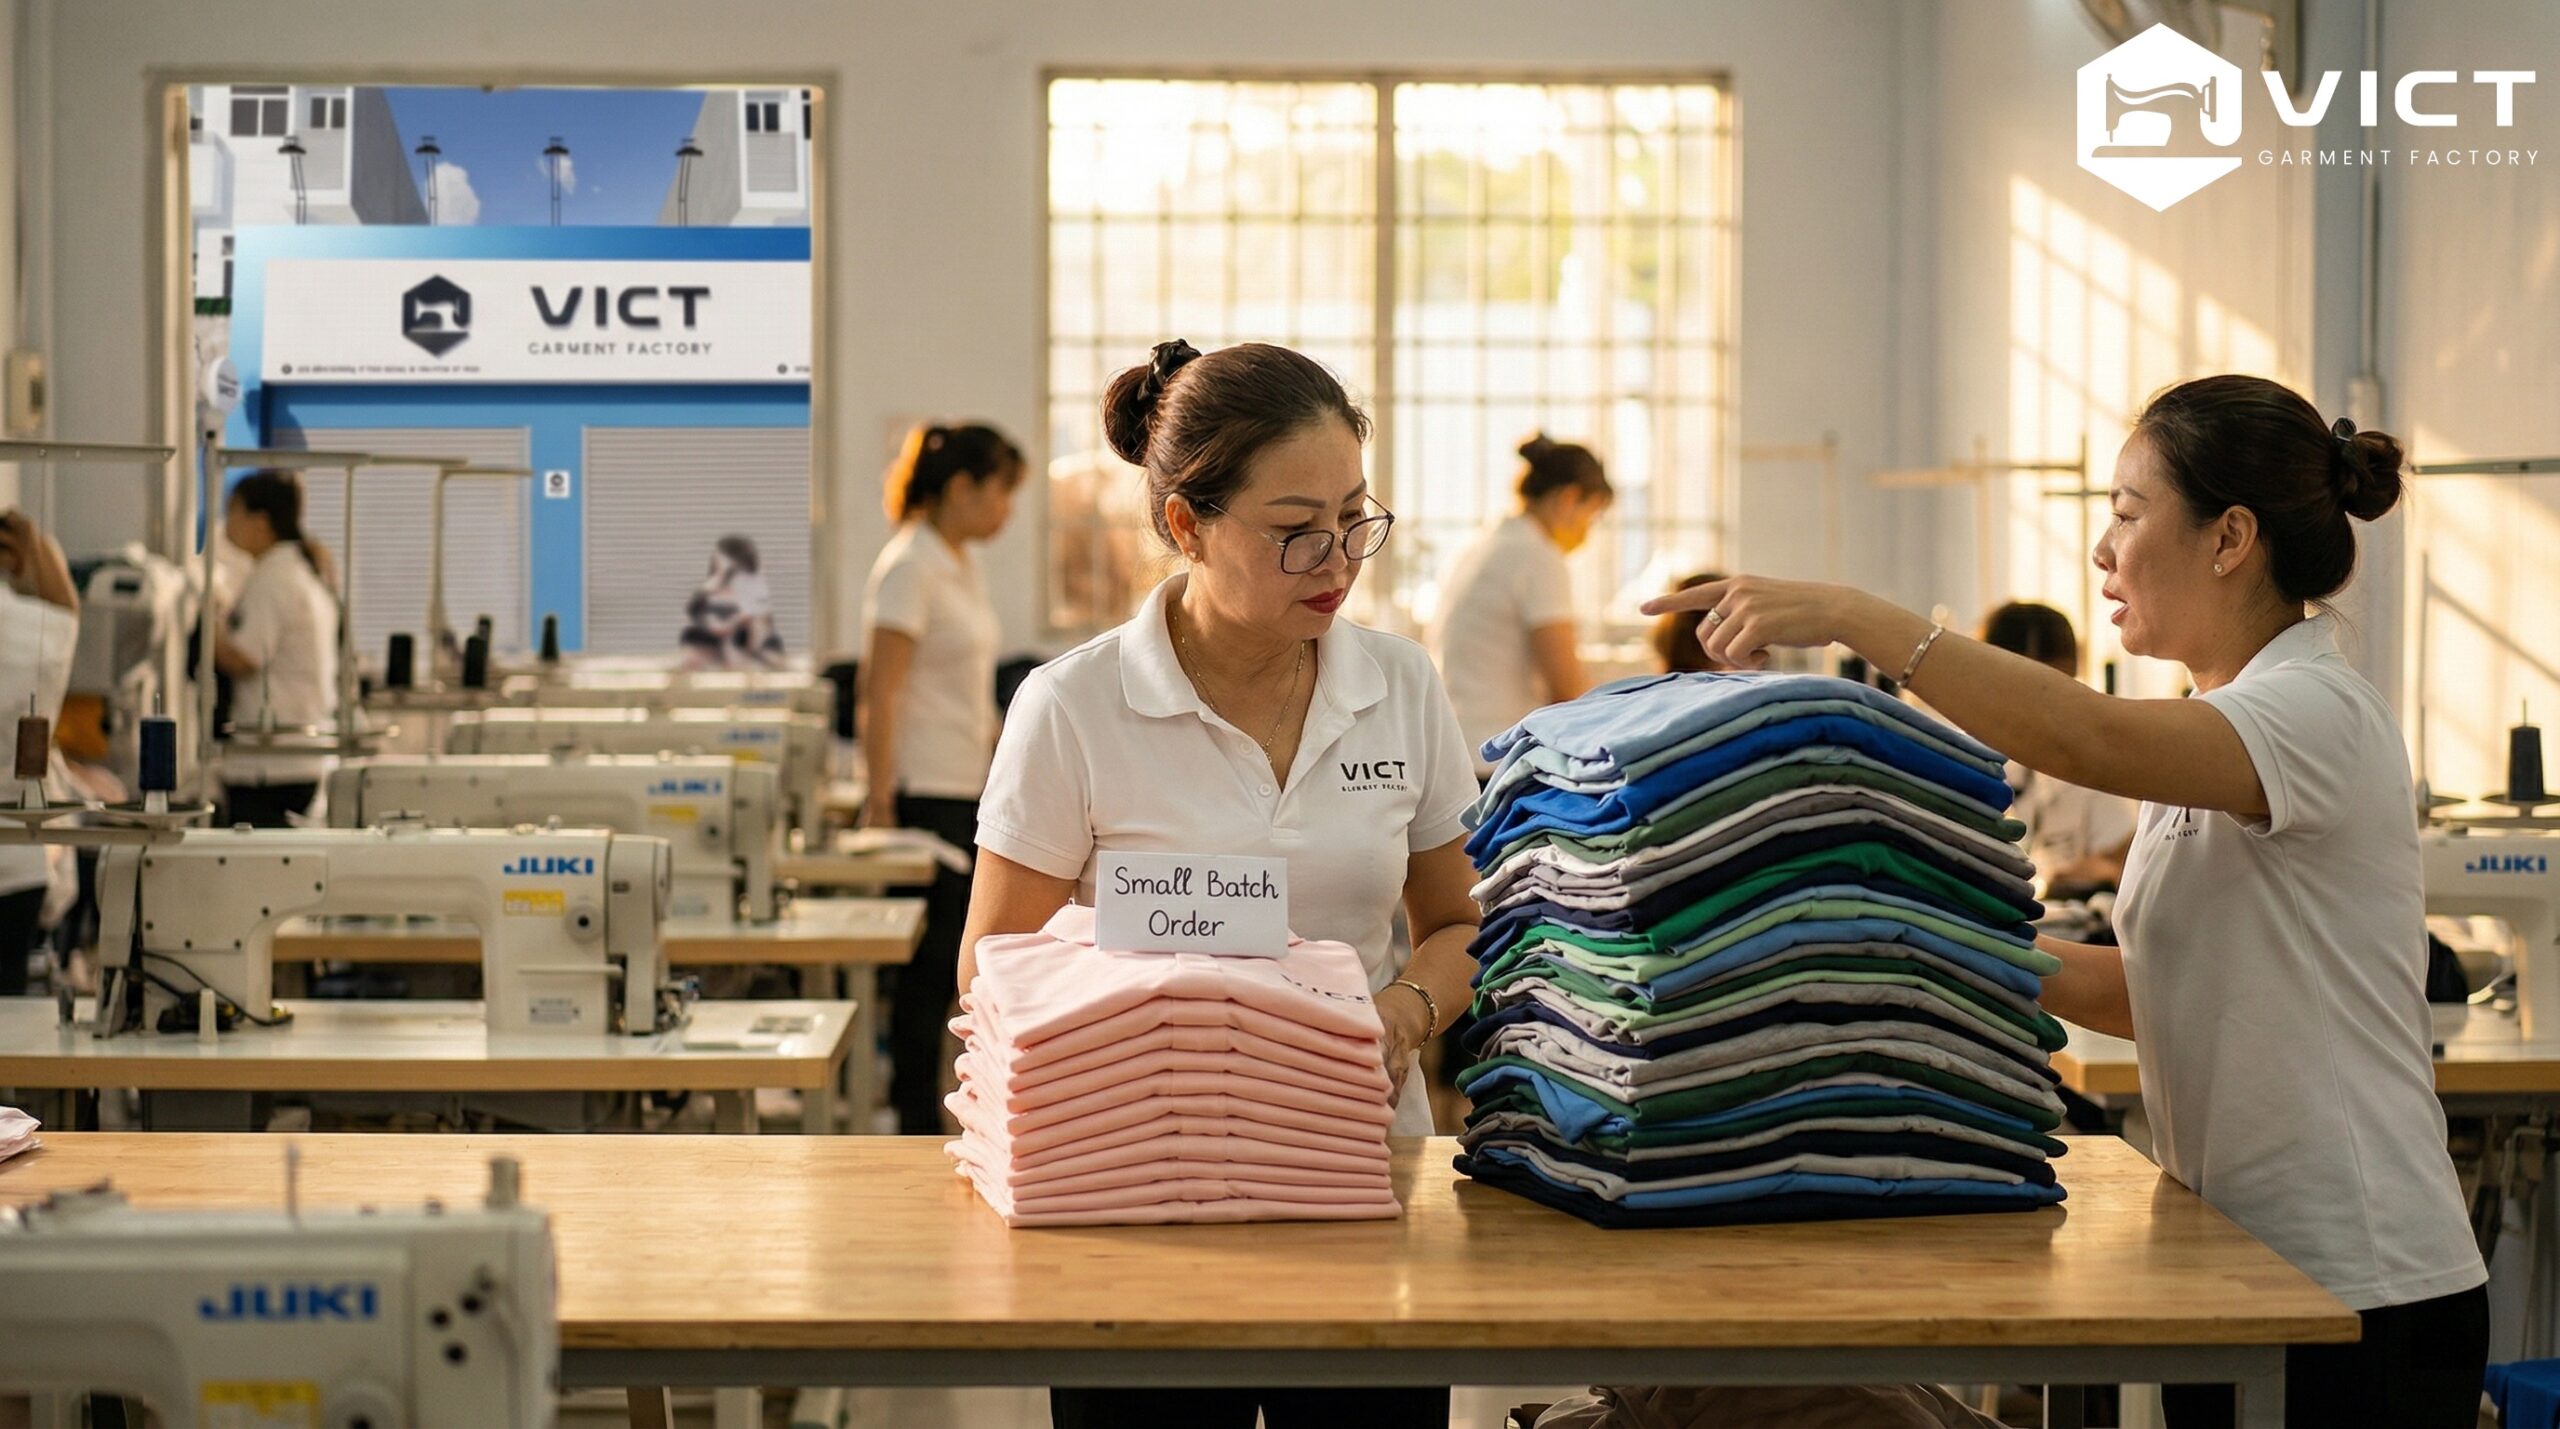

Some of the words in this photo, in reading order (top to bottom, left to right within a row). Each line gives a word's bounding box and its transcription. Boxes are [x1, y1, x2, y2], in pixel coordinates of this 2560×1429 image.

[530, 286, 710, 328] VICT
[627, 342, 712, 355] FACTORY
[1340, 761, 1405, 781] VICT
[503, 857, 594, 875] JUKI
[2465, 854, 2547, 873] JUKI
[1114, 866, 1193, 896] Small
[1207, 870, 1279, 899] Batch
[1148, 910, 1225, 937] Order
[199, 1283, 377, 1321] JUKI
